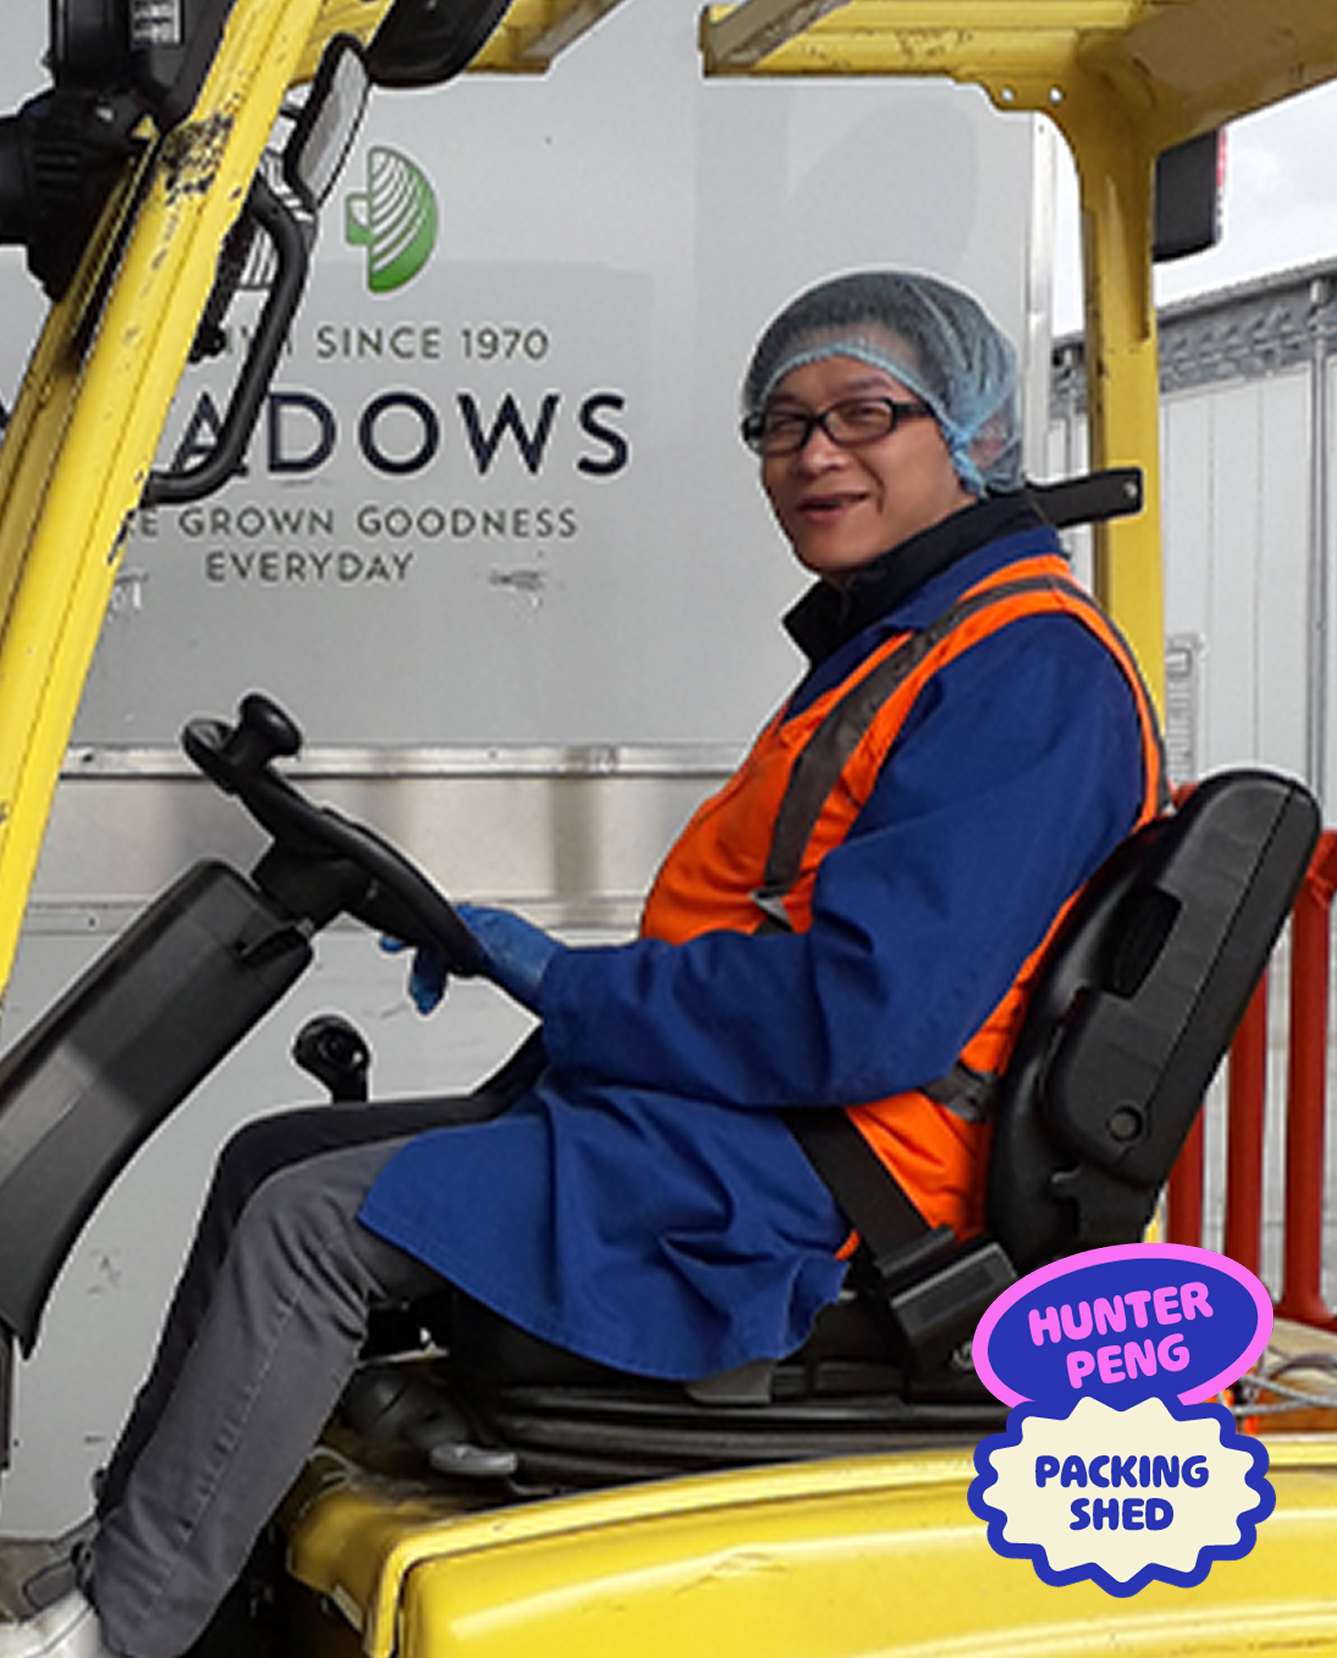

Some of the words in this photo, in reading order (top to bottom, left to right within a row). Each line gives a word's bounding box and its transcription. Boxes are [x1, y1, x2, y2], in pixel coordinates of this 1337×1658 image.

[317, 327, 440, 359] SINCE
[462, 327, 549, 359] 1970
[0, 391, 629, 476] ADOWS
[179, 508, 334, 538] GROWN
[357, 506, 577, 538] GOODNESS
[205, 551, 413, 582] EVERYDAY
